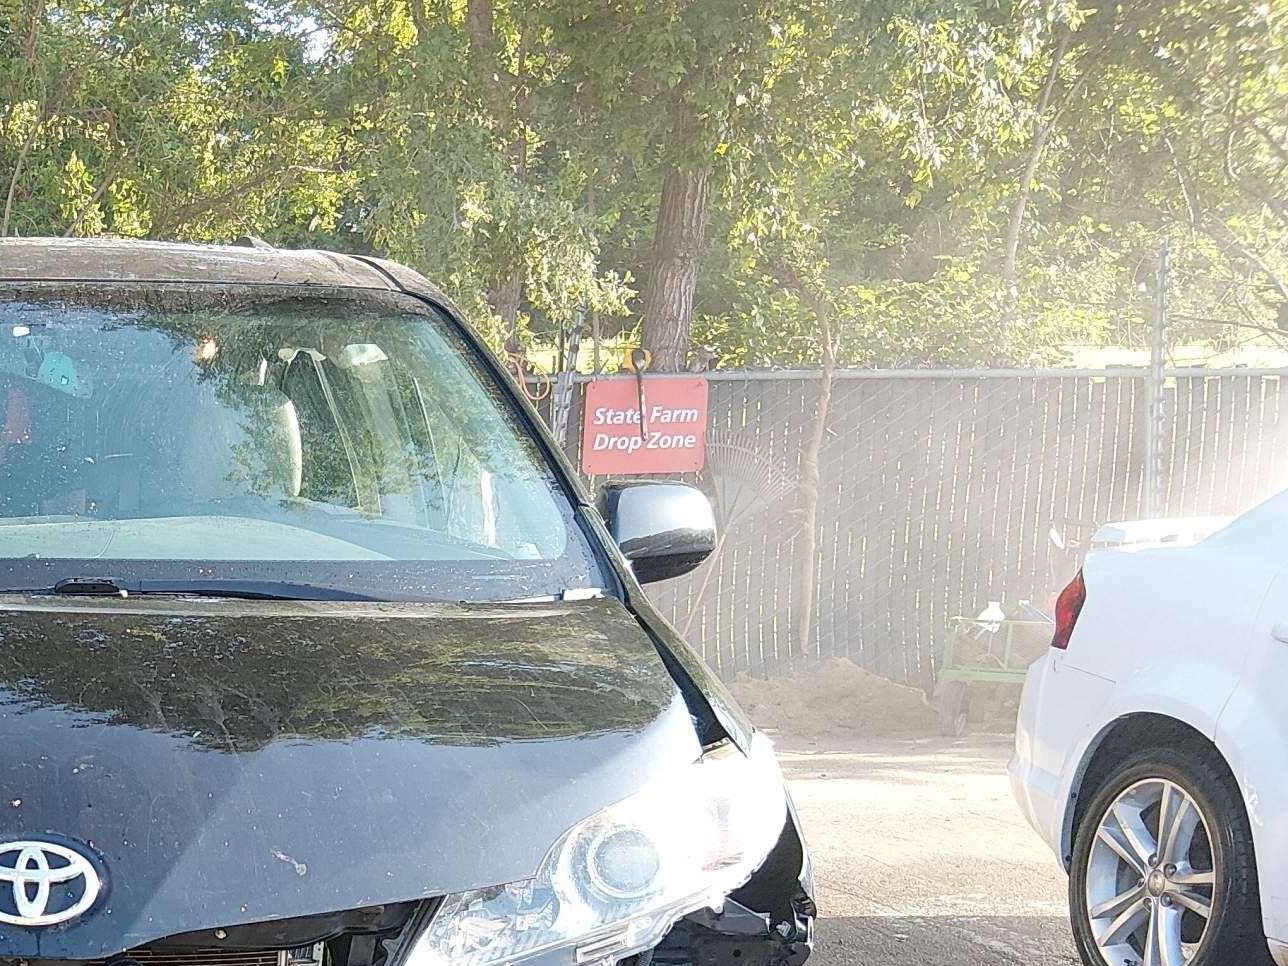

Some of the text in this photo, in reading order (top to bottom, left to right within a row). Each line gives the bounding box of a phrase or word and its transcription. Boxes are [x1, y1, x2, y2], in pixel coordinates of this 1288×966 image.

[593, 406, 698, 425] State Farm
[593, 432, 696, 454] Drop Zone
